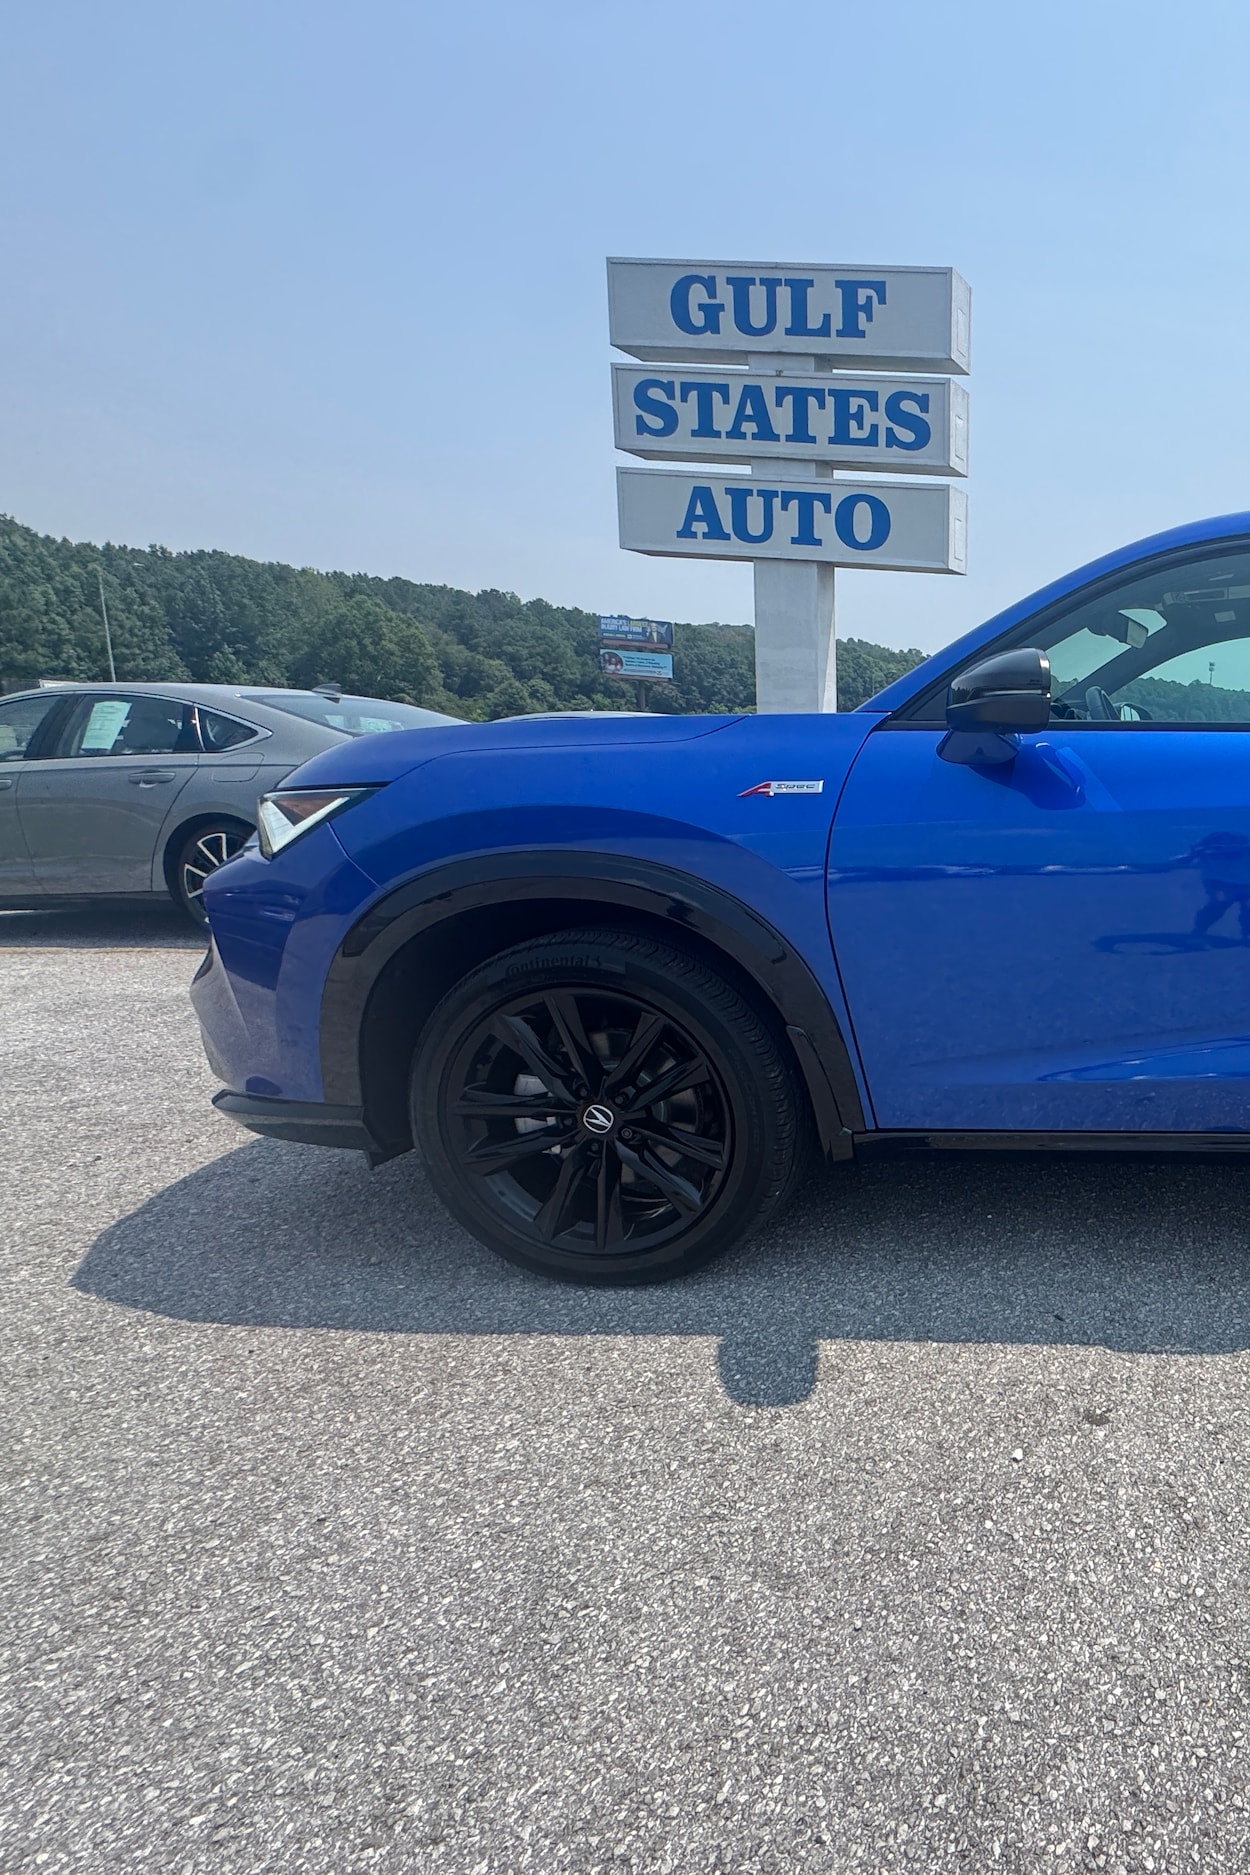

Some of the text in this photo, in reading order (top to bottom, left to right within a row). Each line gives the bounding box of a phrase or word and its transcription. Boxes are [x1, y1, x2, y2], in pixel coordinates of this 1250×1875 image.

[670, 274, 887, 338] GULF
[633, 378, 931, 451] STATES
[676, 485, 891, 551] AUTO
